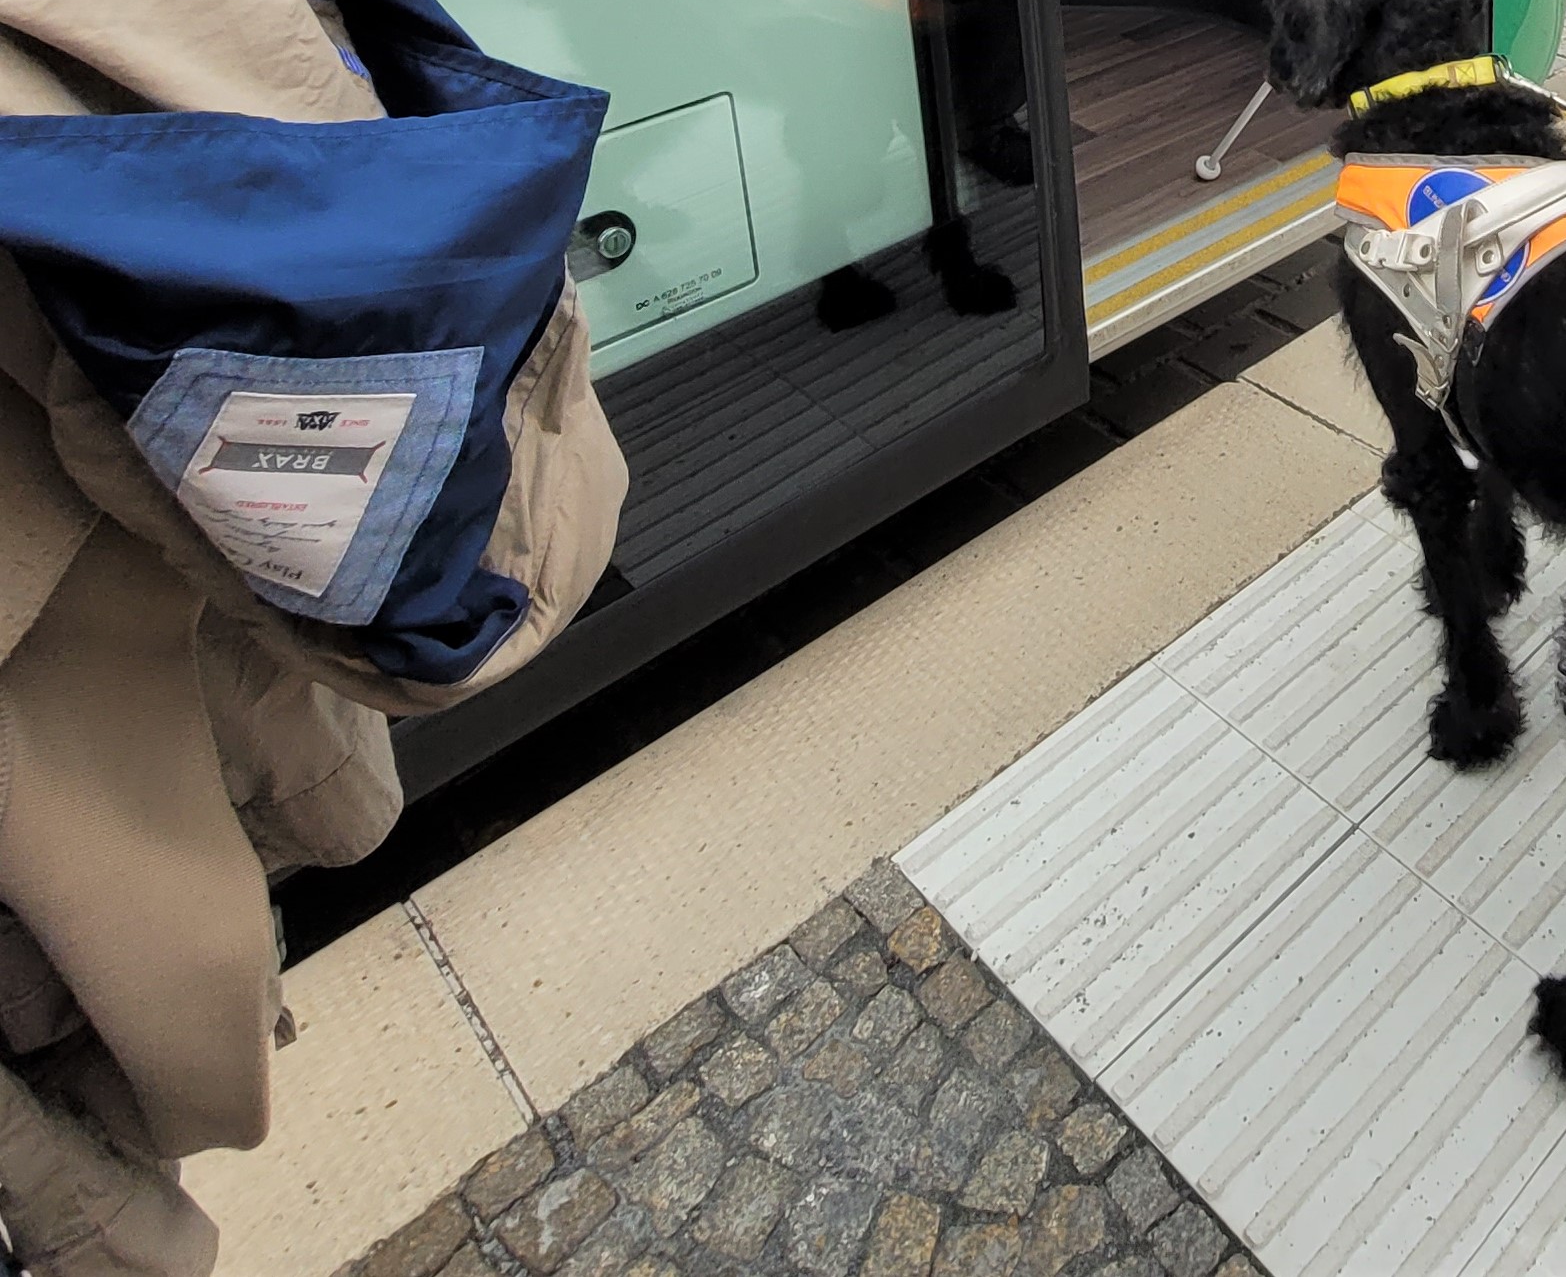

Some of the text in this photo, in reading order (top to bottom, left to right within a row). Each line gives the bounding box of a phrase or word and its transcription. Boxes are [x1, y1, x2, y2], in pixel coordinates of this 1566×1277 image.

[635, 299, 650, 311] DC
[252, 452, 331, 470] BRAX
[259, 559, 303, 580] Play
